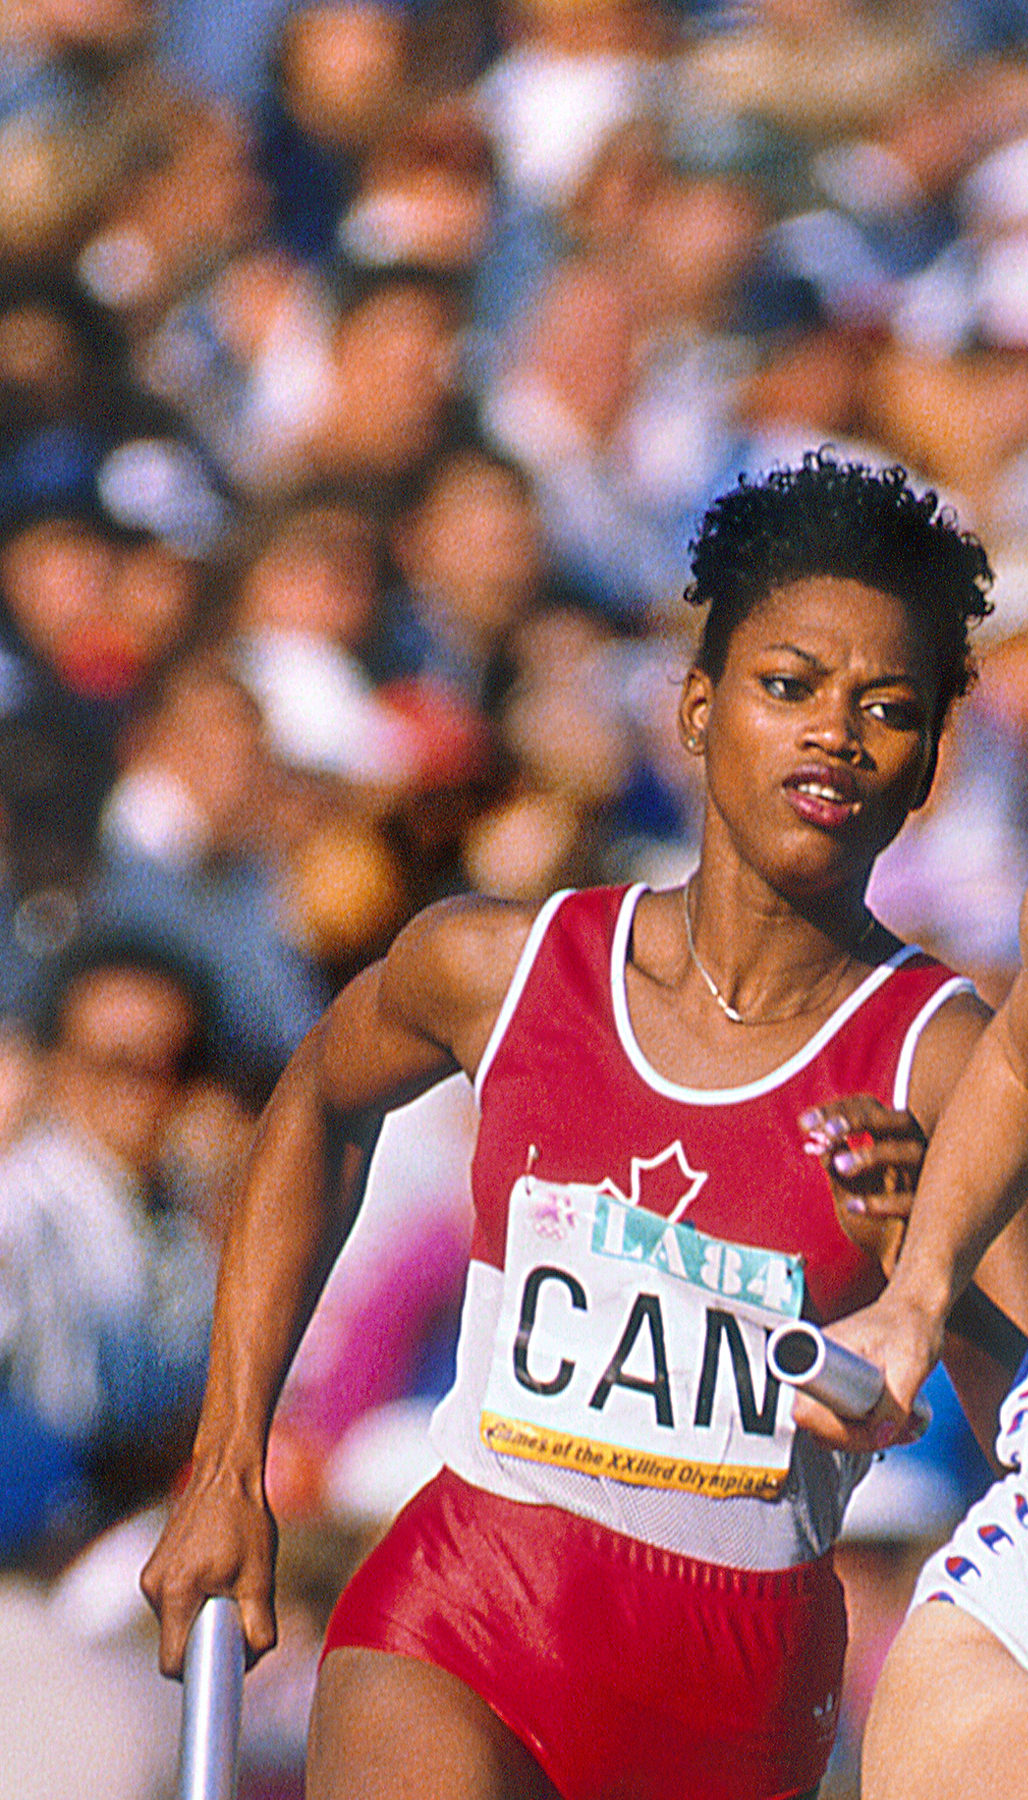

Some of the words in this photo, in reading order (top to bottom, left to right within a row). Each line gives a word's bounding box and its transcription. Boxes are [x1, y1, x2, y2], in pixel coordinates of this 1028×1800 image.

[512, 1265, 782, 1436] CAN
[552, 1440, 573, 1457] of
[575, 1446, 603, 1465] the
